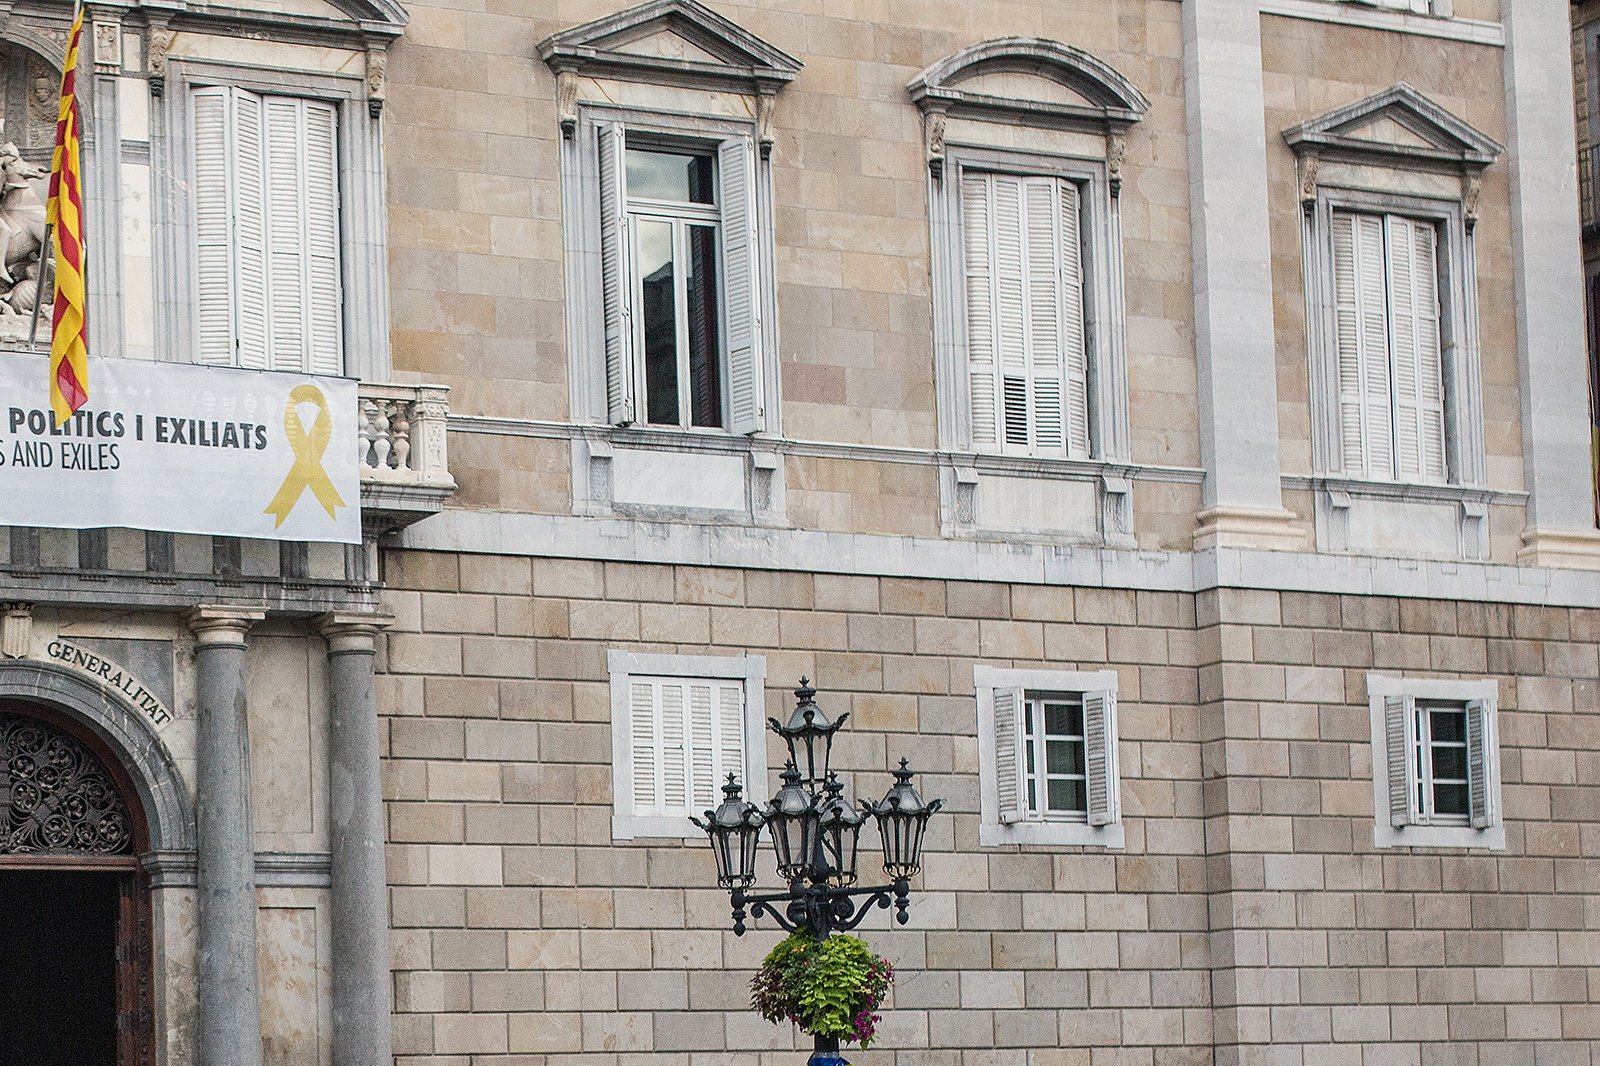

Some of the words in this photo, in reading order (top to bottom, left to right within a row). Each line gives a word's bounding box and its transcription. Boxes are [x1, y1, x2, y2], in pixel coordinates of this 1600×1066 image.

[135, 414, 144, 441] I
[155, 415, 268, 451] EXILIATS
[12, 440, 53, 468] AND
[60, 442, 121, 471] EXILES
[46, 641, 173, 727] GENERALITAT
